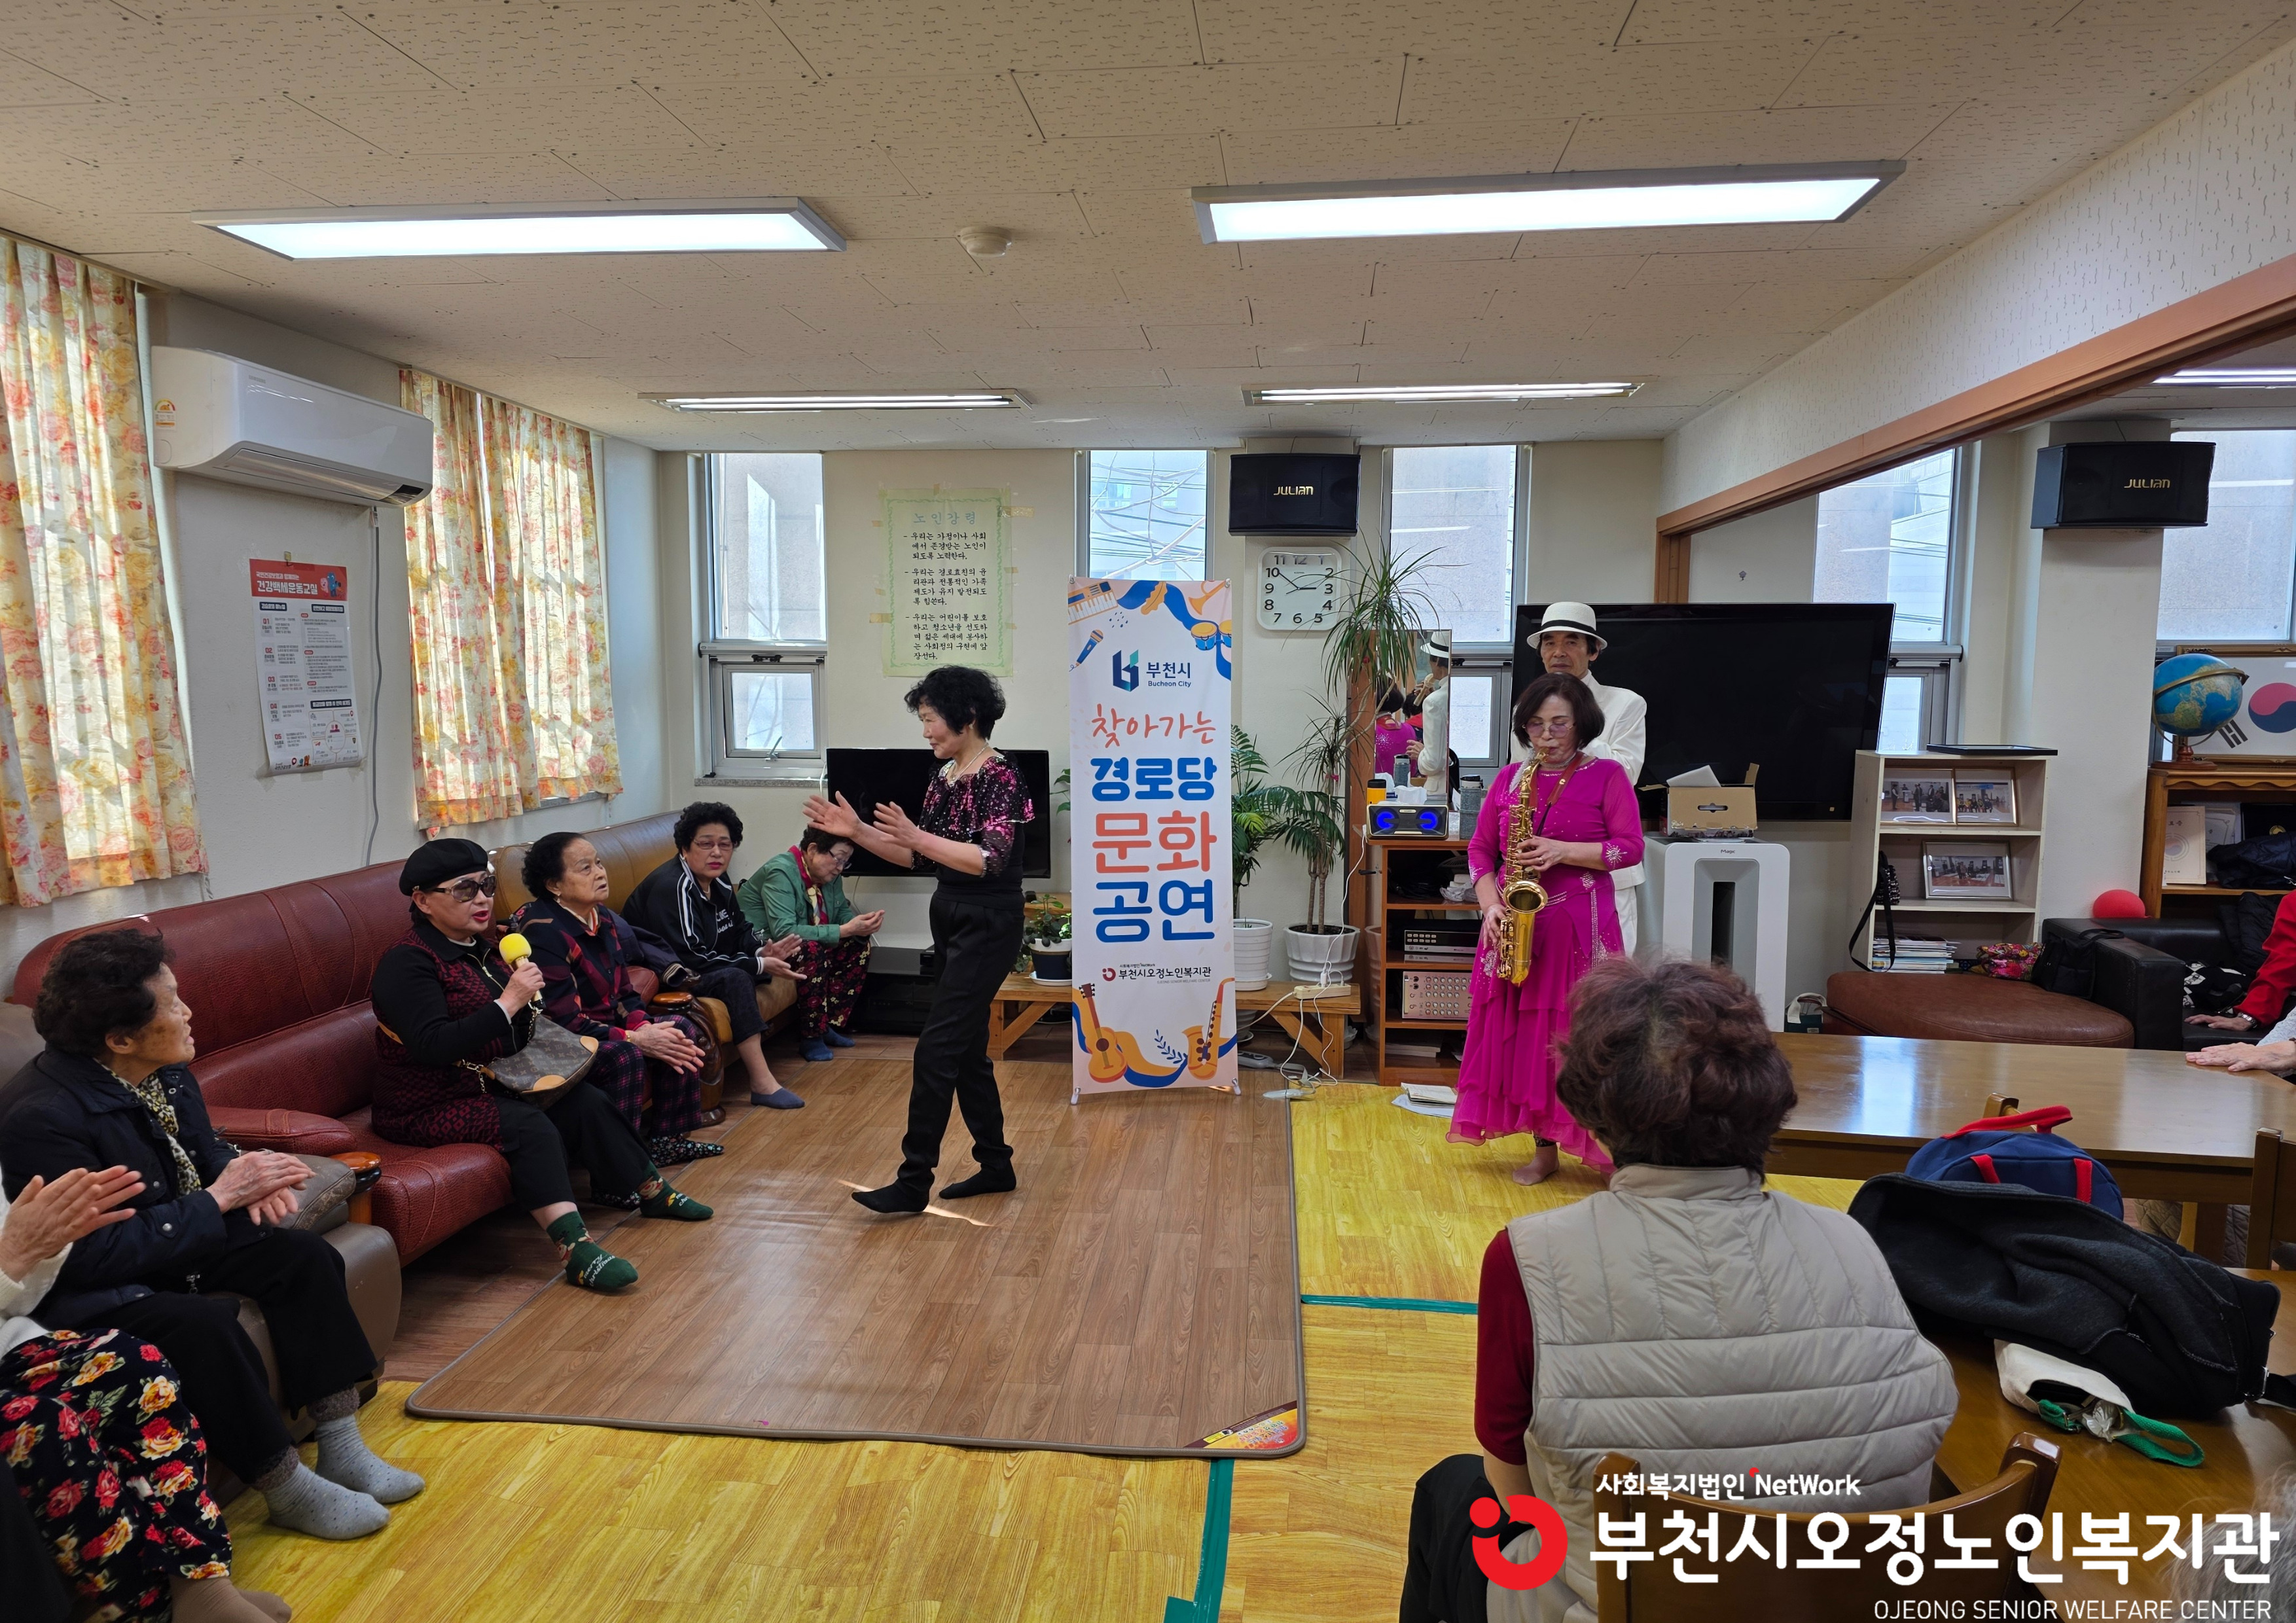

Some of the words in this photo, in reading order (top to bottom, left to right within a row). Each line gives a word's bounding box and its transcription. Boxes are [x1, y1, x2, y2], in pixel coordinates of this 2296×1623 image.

[2124, 479, 2170, 489] JULIAN
[1274, 486, 1314, 495] JULIAN
[1274, 555, 1285, 565] 11
[1293, 555, 1307, 565] 12
[1318, 555, 1323, 565] 1
[1266, 567, 1280, 577] 10
[1325, 568, 1333, 578] 2
[257, 580, 318, 595] 건강백세운동교실
[1265, 583, 1274, 594] 9
[1324, 584, 1333, 594] 3
[1265, 599, 1274, 610] 8
[1322, 600, 1333, 610] 4
[1274, 613, 1282, 623] 7
[1293, 613, 1302, 624] 6
[1314, 613, 1323, 623] 5
[1146, 662, 1191, 679] 부천시
[1091, 704, 1216, 749] 찾아가는
[1090, 757, 1217, 802] 경로당
[1092, 810, 1217, 874] 문화
[1092, 879, 1215, 943] 공연
[1119, 967, 1211, 980] 부천시오정노인복지관
